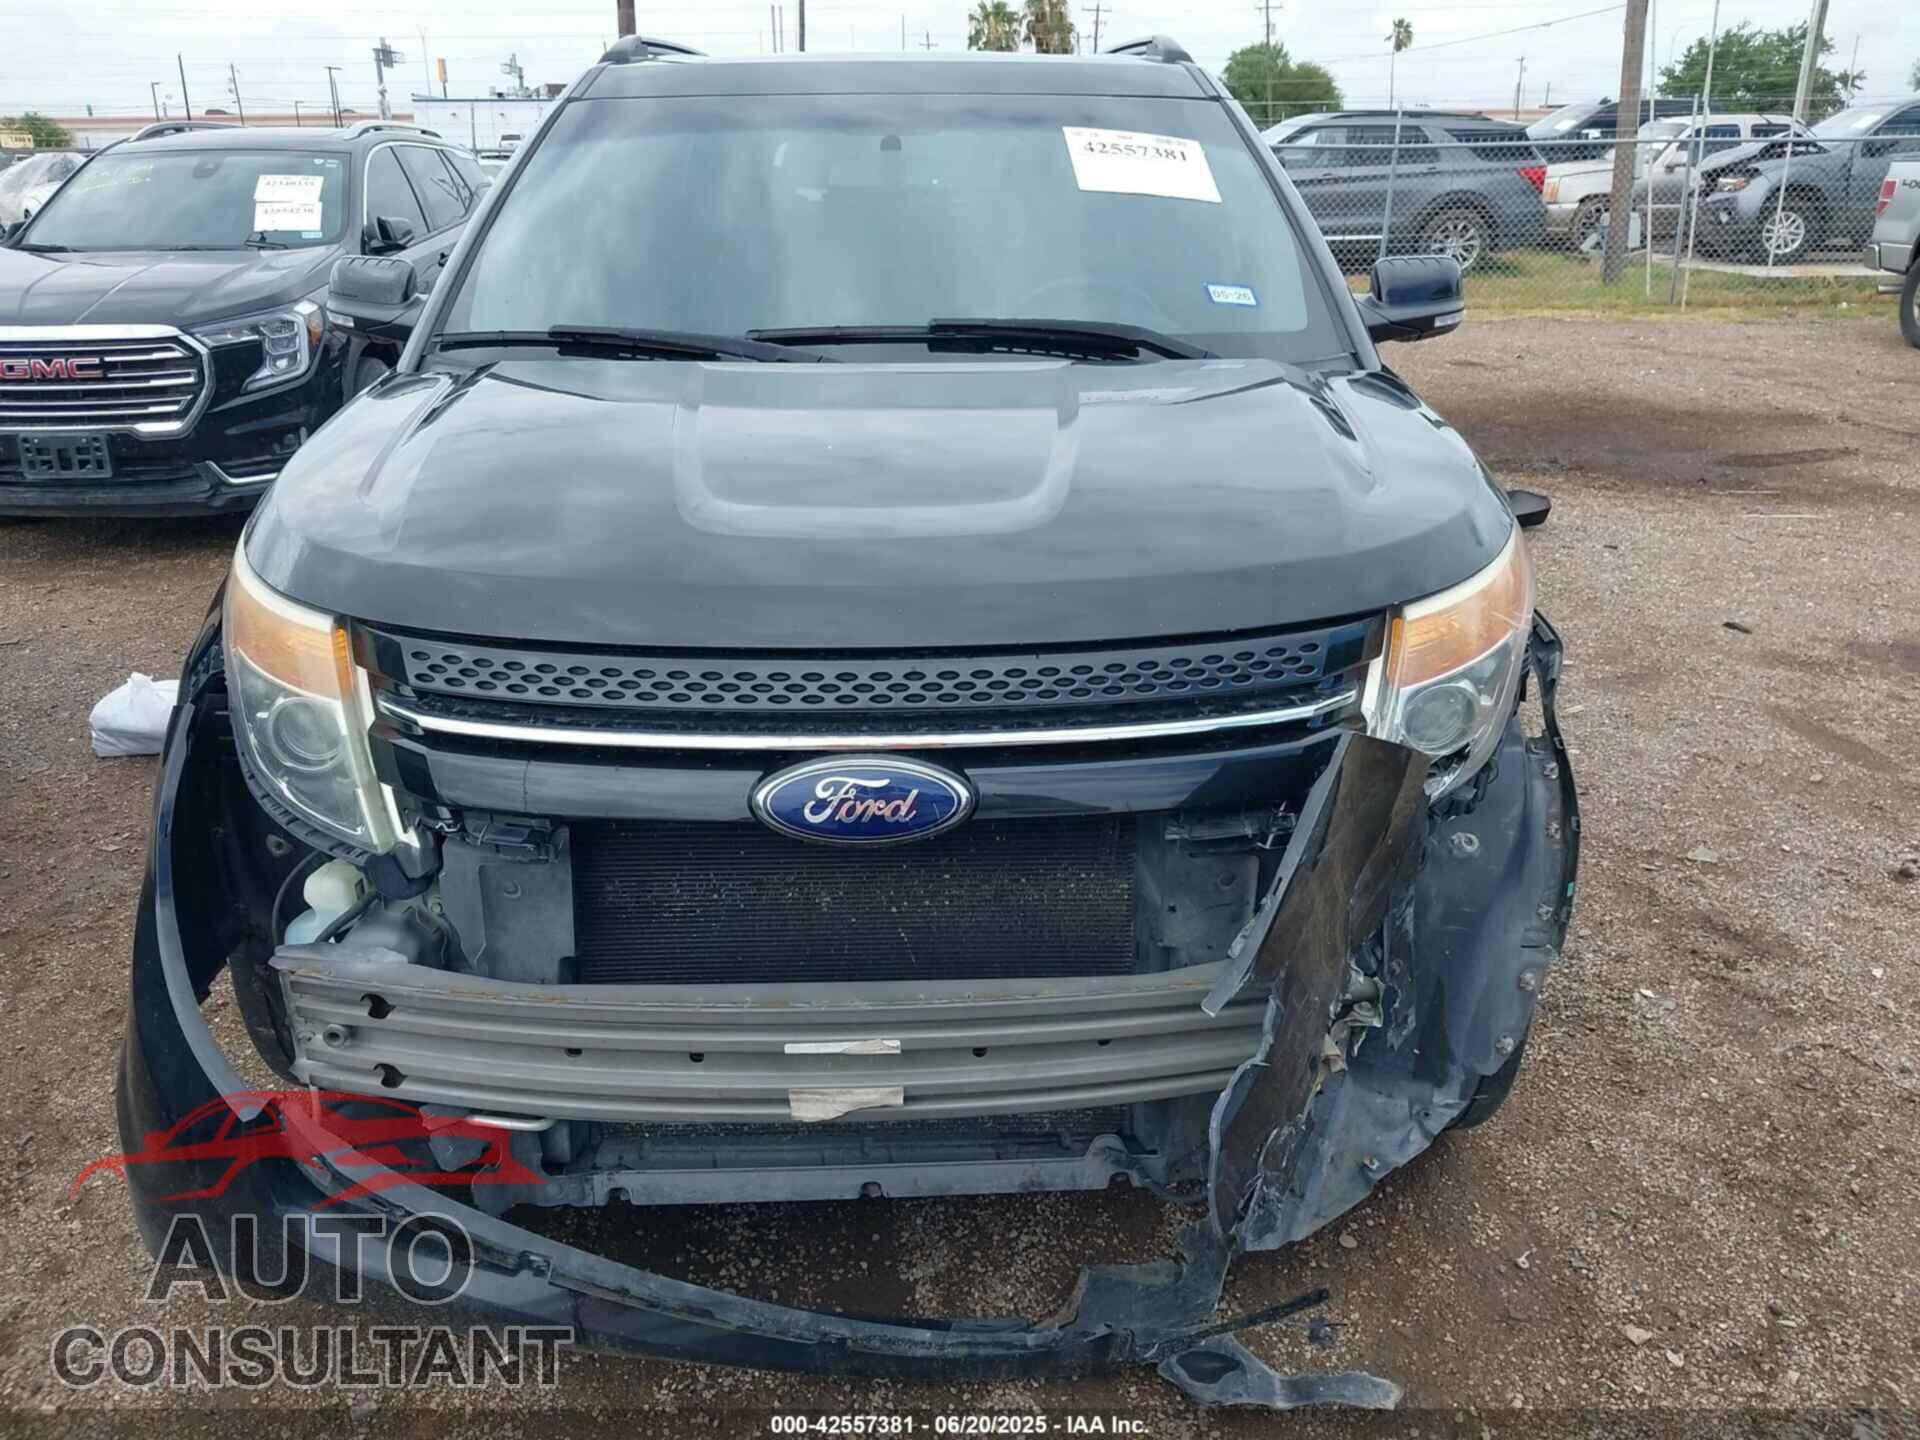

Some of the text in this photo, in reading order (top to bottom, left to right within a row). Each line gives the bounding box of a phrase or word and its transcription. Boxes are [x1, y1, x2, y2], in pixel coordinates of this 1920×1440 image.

[1082, 141, 1188, 162] 42557381
[0, 358, 103, 379] GMC
[804, 776, 920, 824] Ford
